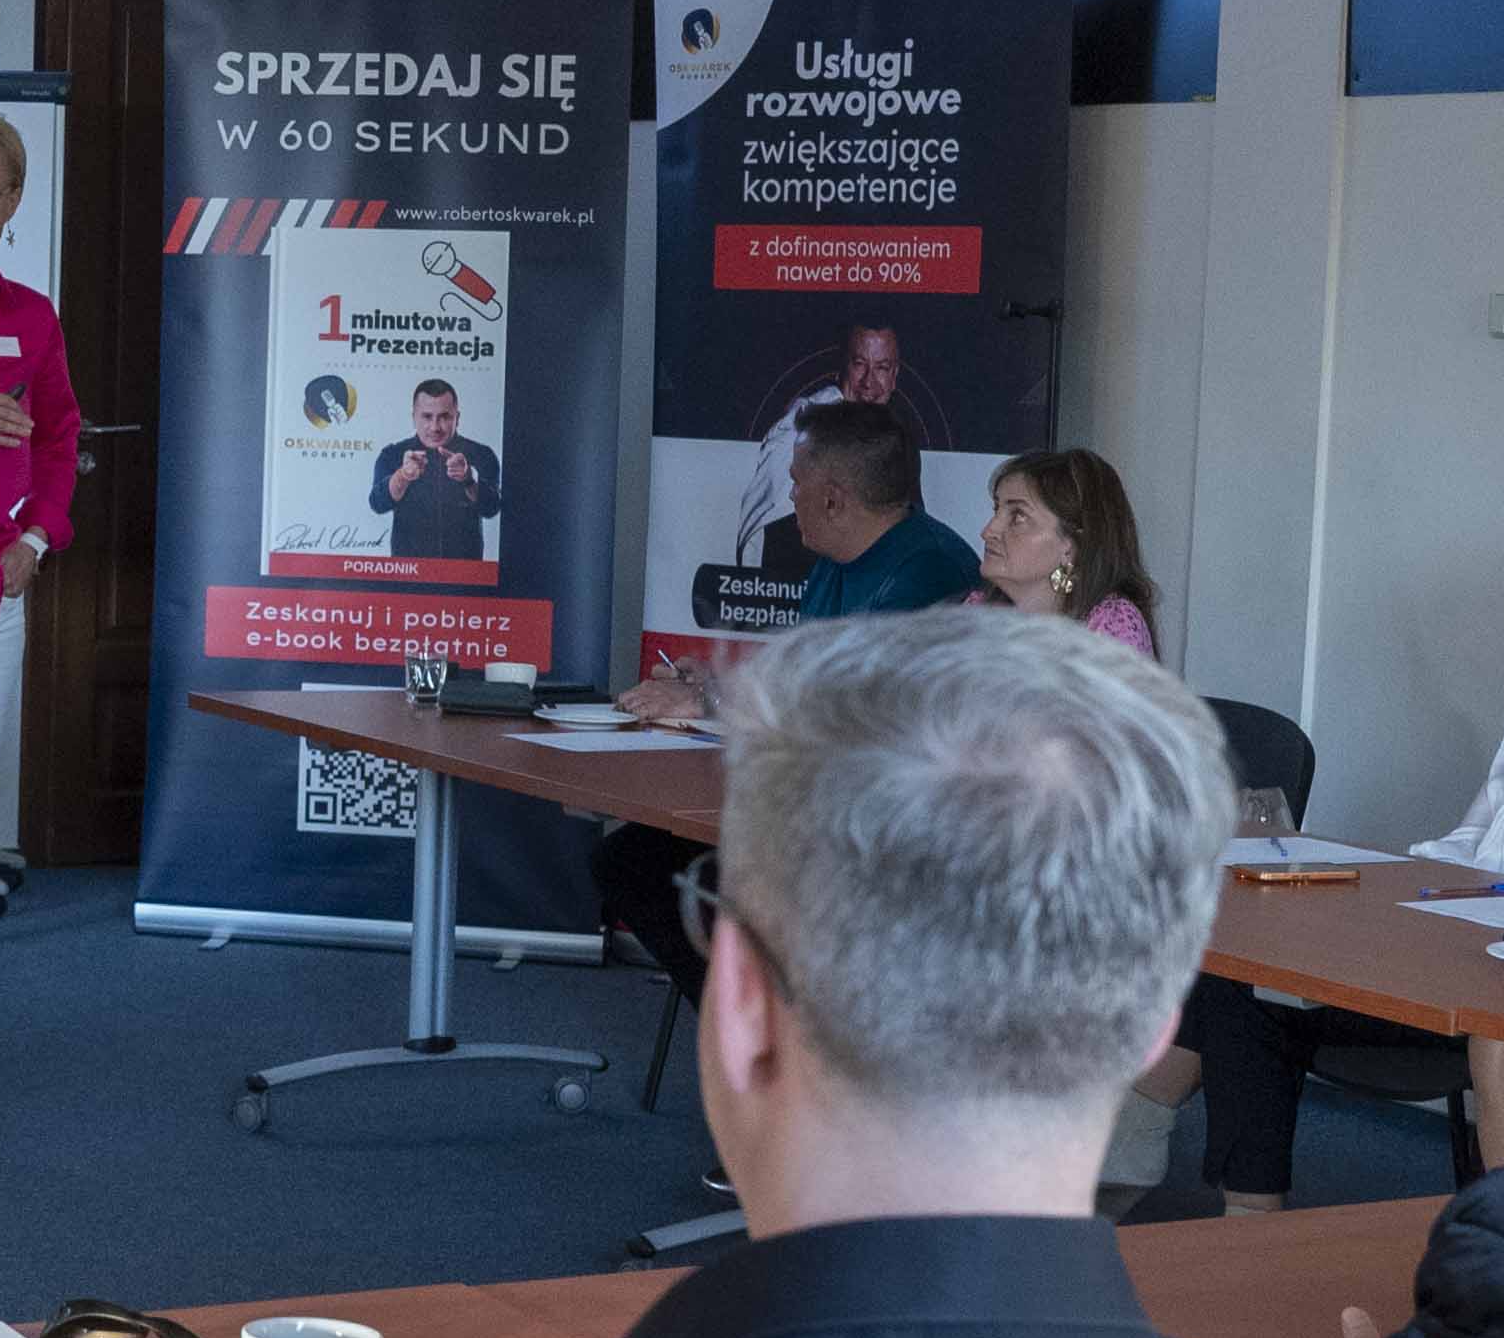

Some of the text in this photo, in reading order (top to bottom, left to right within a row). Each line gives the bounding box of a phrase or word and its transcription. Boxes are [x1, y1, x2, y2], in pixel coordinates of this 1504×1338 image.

[795, 38, 914, 89] Usługi
[213, 51, 577, 112] SPRZEDAJ SIĘ
[745, 78, 962, 127] rozwojowe
[215, 119, 571, 156] W 60 SEKUND
[743, 130, 960, 172] zwiększające
[743, 171, 958, 212] kompetencje
[395, 206, 595, 228] www.robertoskwarek.pl
[749, 235, 951, 260] z dofinansowaniem
[776, 262, 922, 284] nawet do 90%
[318, 294, 472, 342] 1 minutowa
[350, 334, 495, 361] Prezentacja
[284, 437, 374, 452] OSKWAREK
[343, 560, 419, 575] PORADNIK
[246, 601, 511, 632] Zeskanuj i pobierz
[246, 629, 508, 657] e-book bezpłatnie
